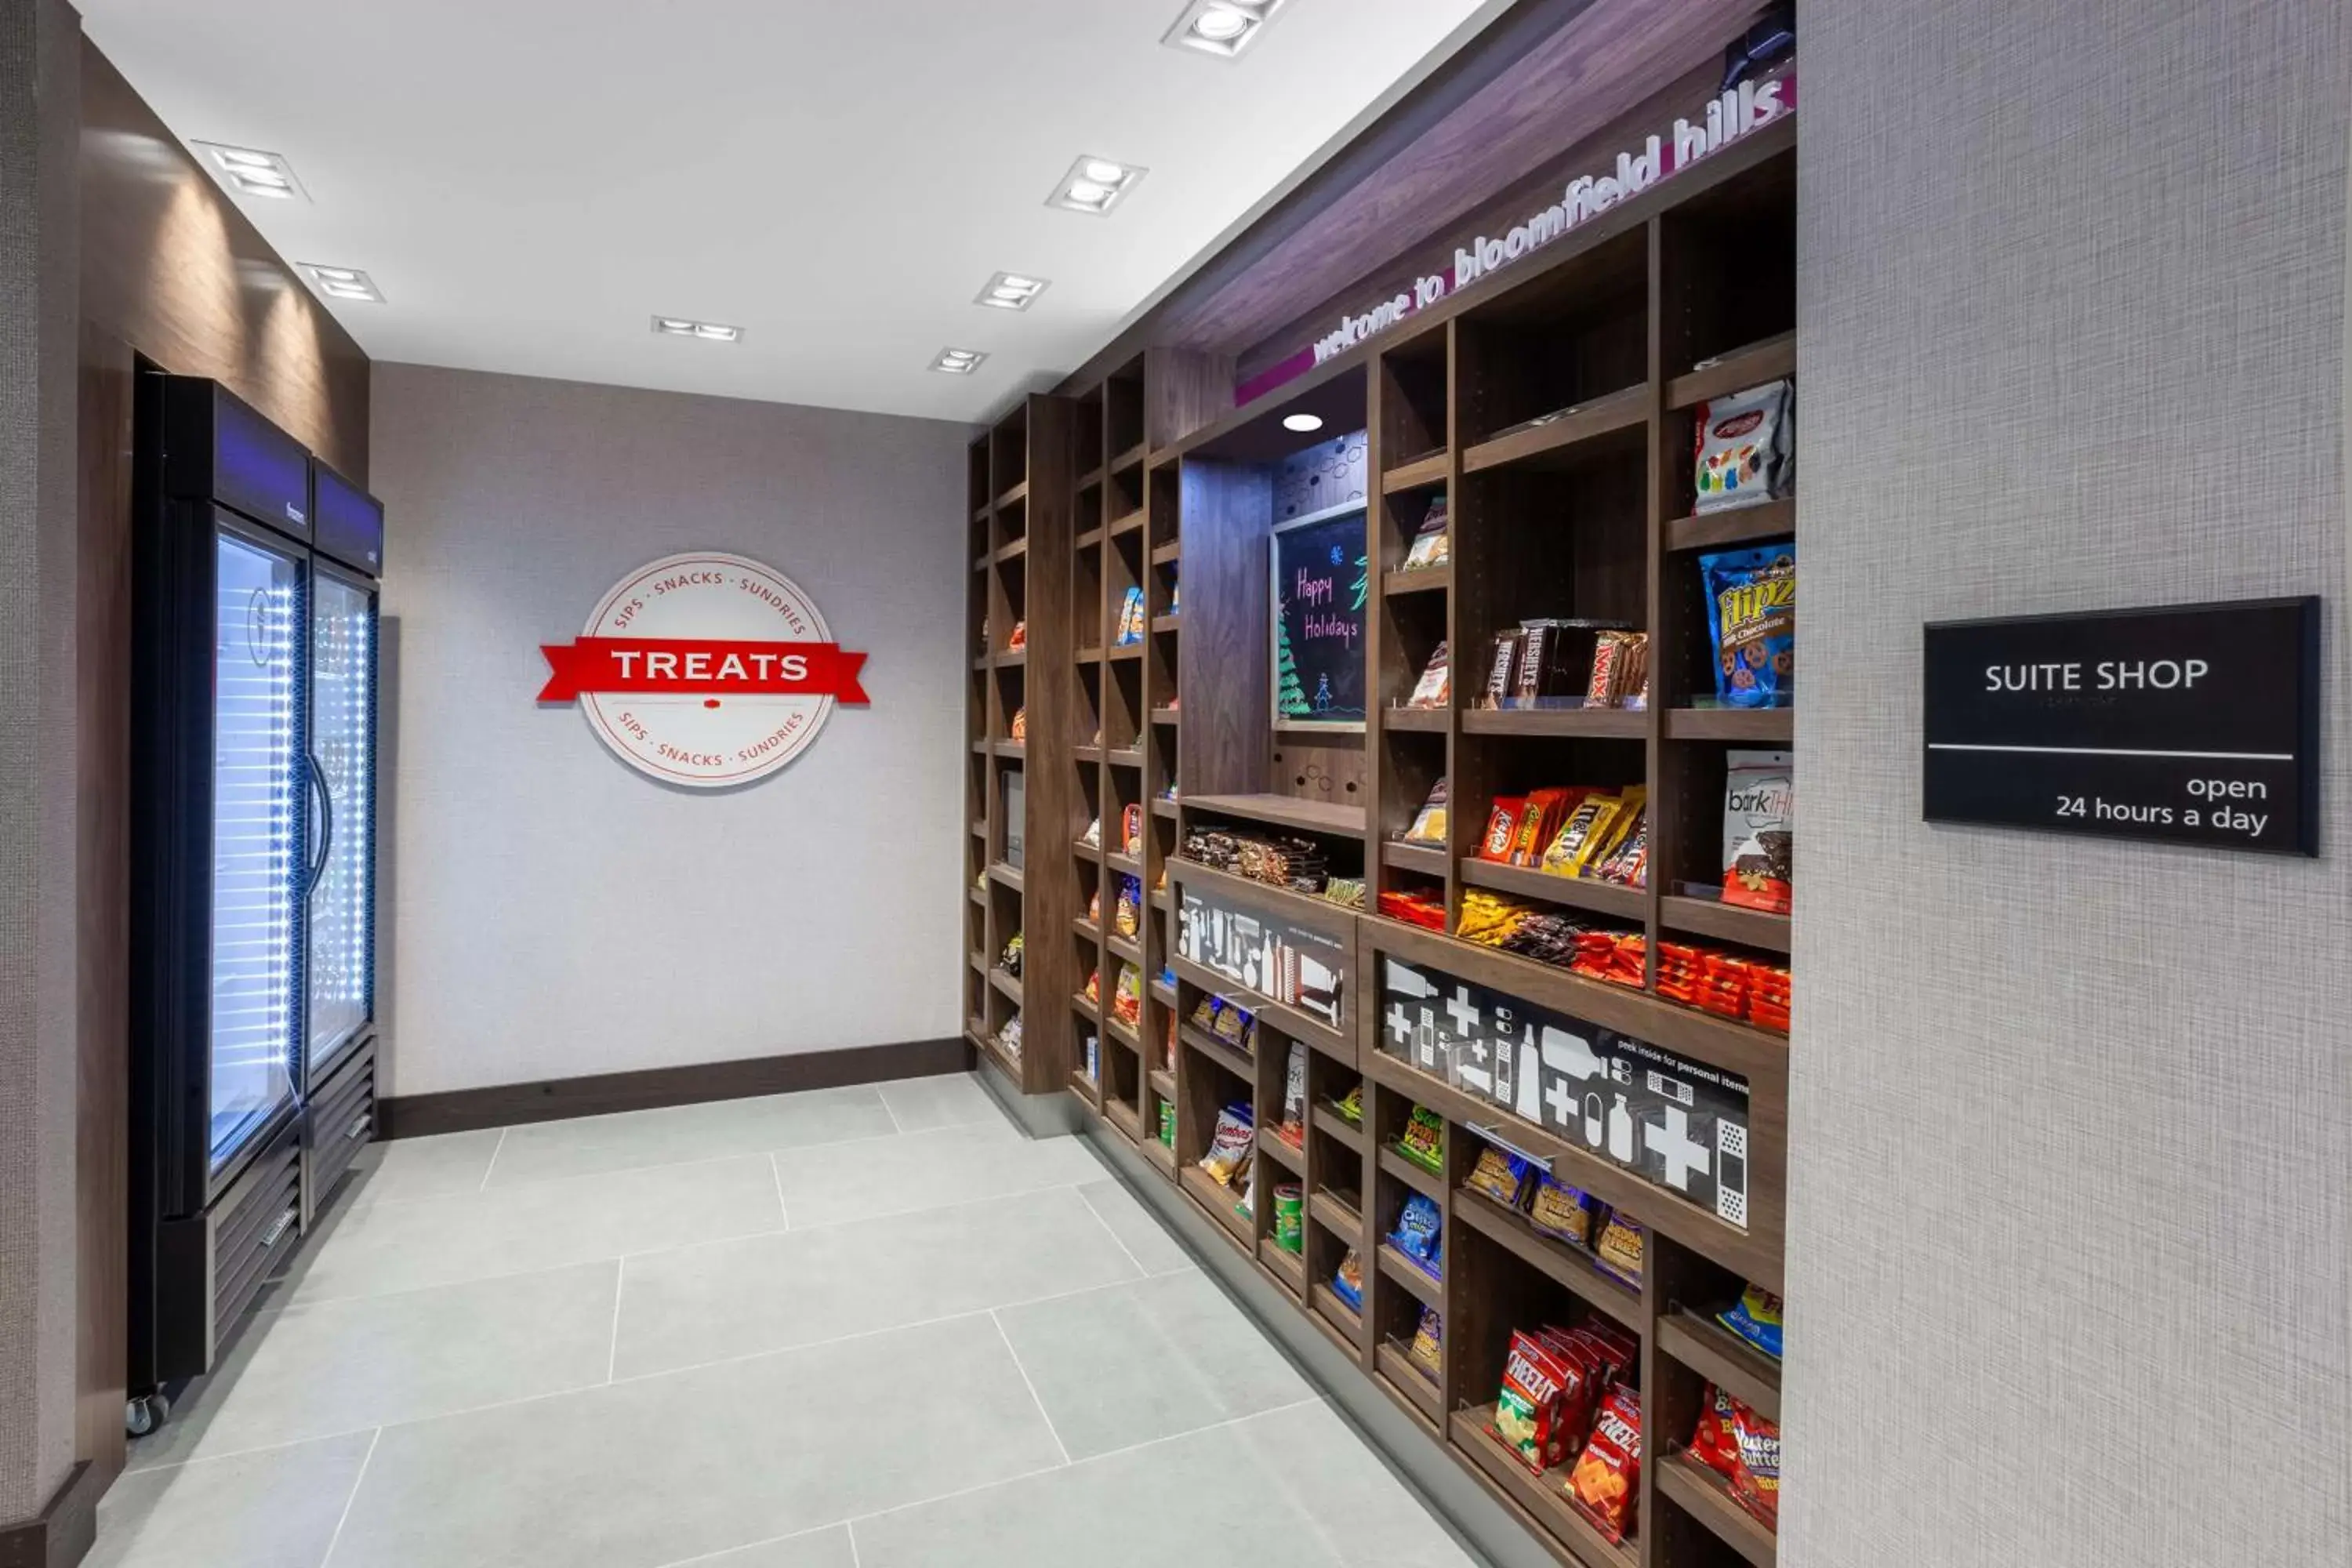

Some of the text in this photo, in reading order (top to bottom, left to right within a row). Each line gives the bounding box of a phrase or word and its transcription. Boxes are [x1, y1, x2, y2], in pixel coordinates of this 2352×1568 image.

[1314, 79, 1783, 363] welcome to bloomfield hills
[615, 572, 806, 636] SIPS SNACKS SUNDRIES
[1297, 566, 1332, 607] Happy
[1305, 613, 1357, 650] Holidays
[611, 650, 808, 681] TREATS
[1986, 659, 2209, 691] SUITE SHOP
[619, 712, 804, 766] SIPS SNACKS SUNDRIES
[2187, 779, 2267, 801] open
[2056, 796, 2268, 837] 24 hours a day
[1617, 1040, 1750, 1094] peek inside for personal items
